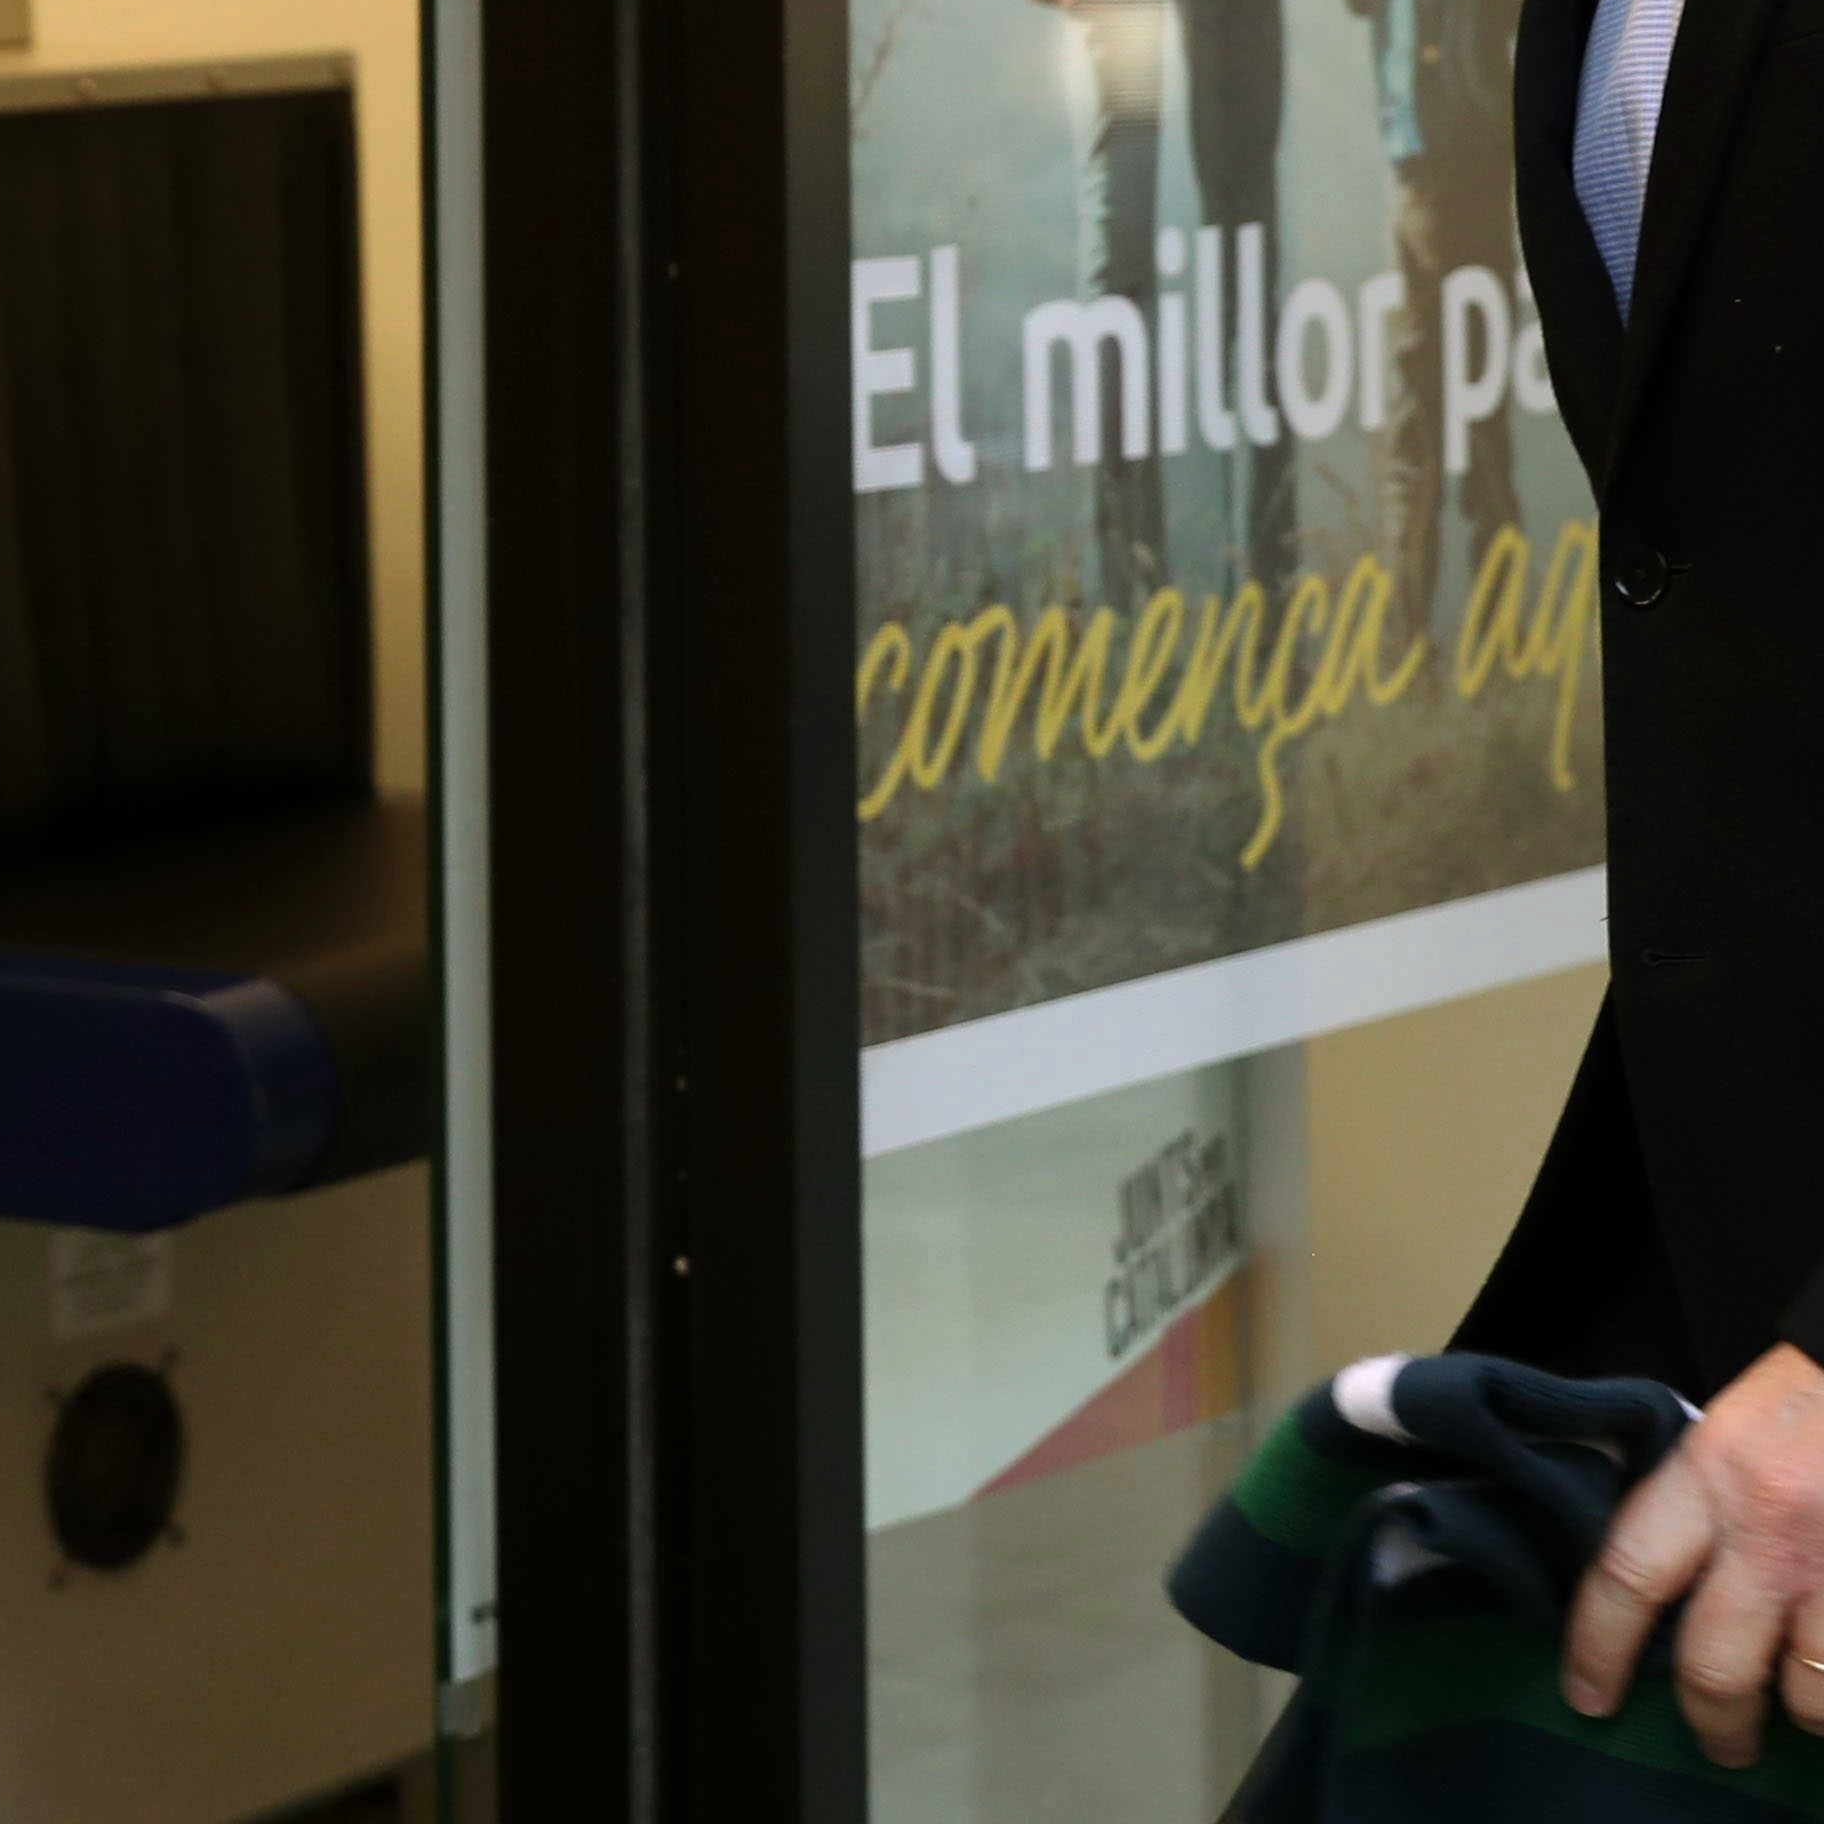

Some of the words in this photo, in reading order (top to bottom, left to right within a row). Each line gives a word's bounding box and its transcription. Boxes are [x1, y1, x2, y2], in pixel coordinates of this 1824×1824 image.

[849, 242, 975, 494] El
[1021, 222, 1406, 474] millor
[856, 552, 1428, 871] comença
